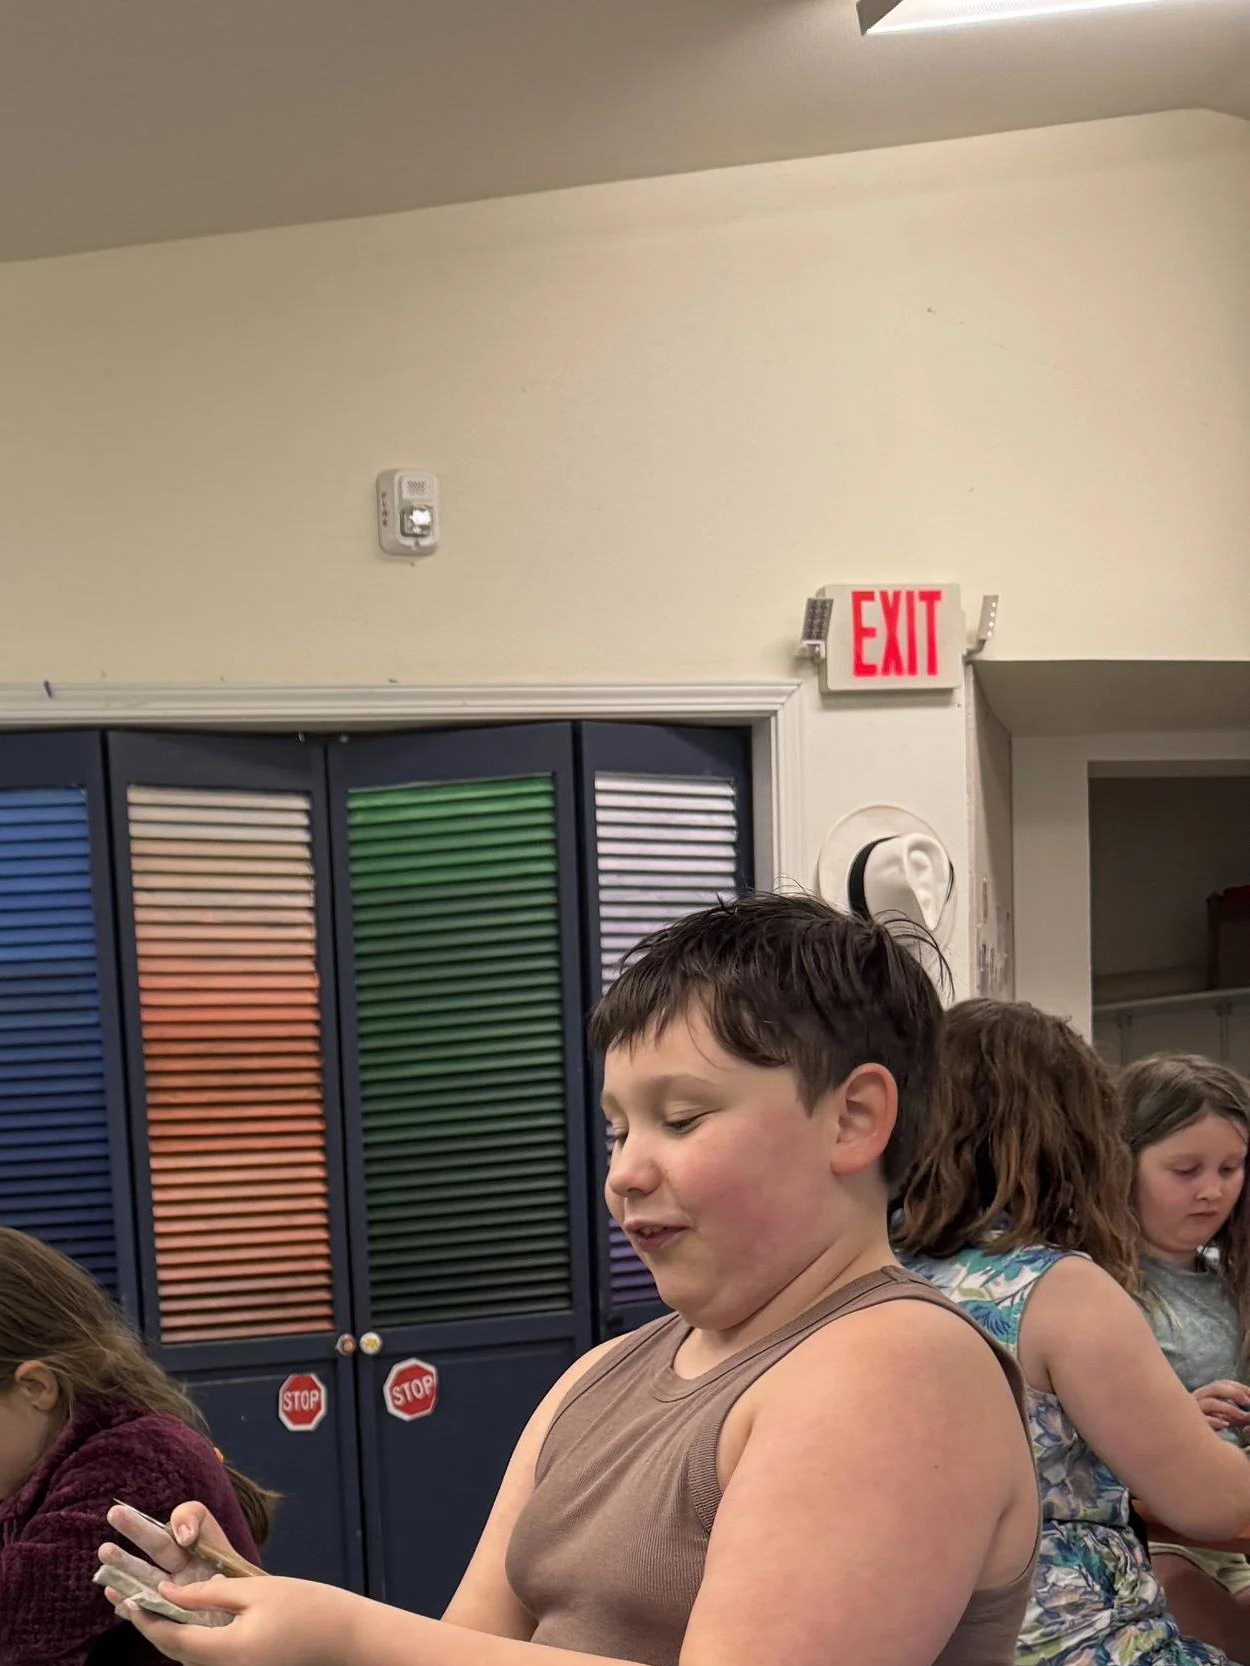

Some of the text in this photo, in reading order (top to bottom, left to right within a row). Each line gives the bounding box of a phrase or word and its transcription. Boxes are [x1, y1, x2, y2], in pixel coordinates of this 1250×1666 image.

[851, 589, 942, 678] EXIT
[282, 1388, 320, 1412] STOP
[391, 1374, 434, 1407] STOP
